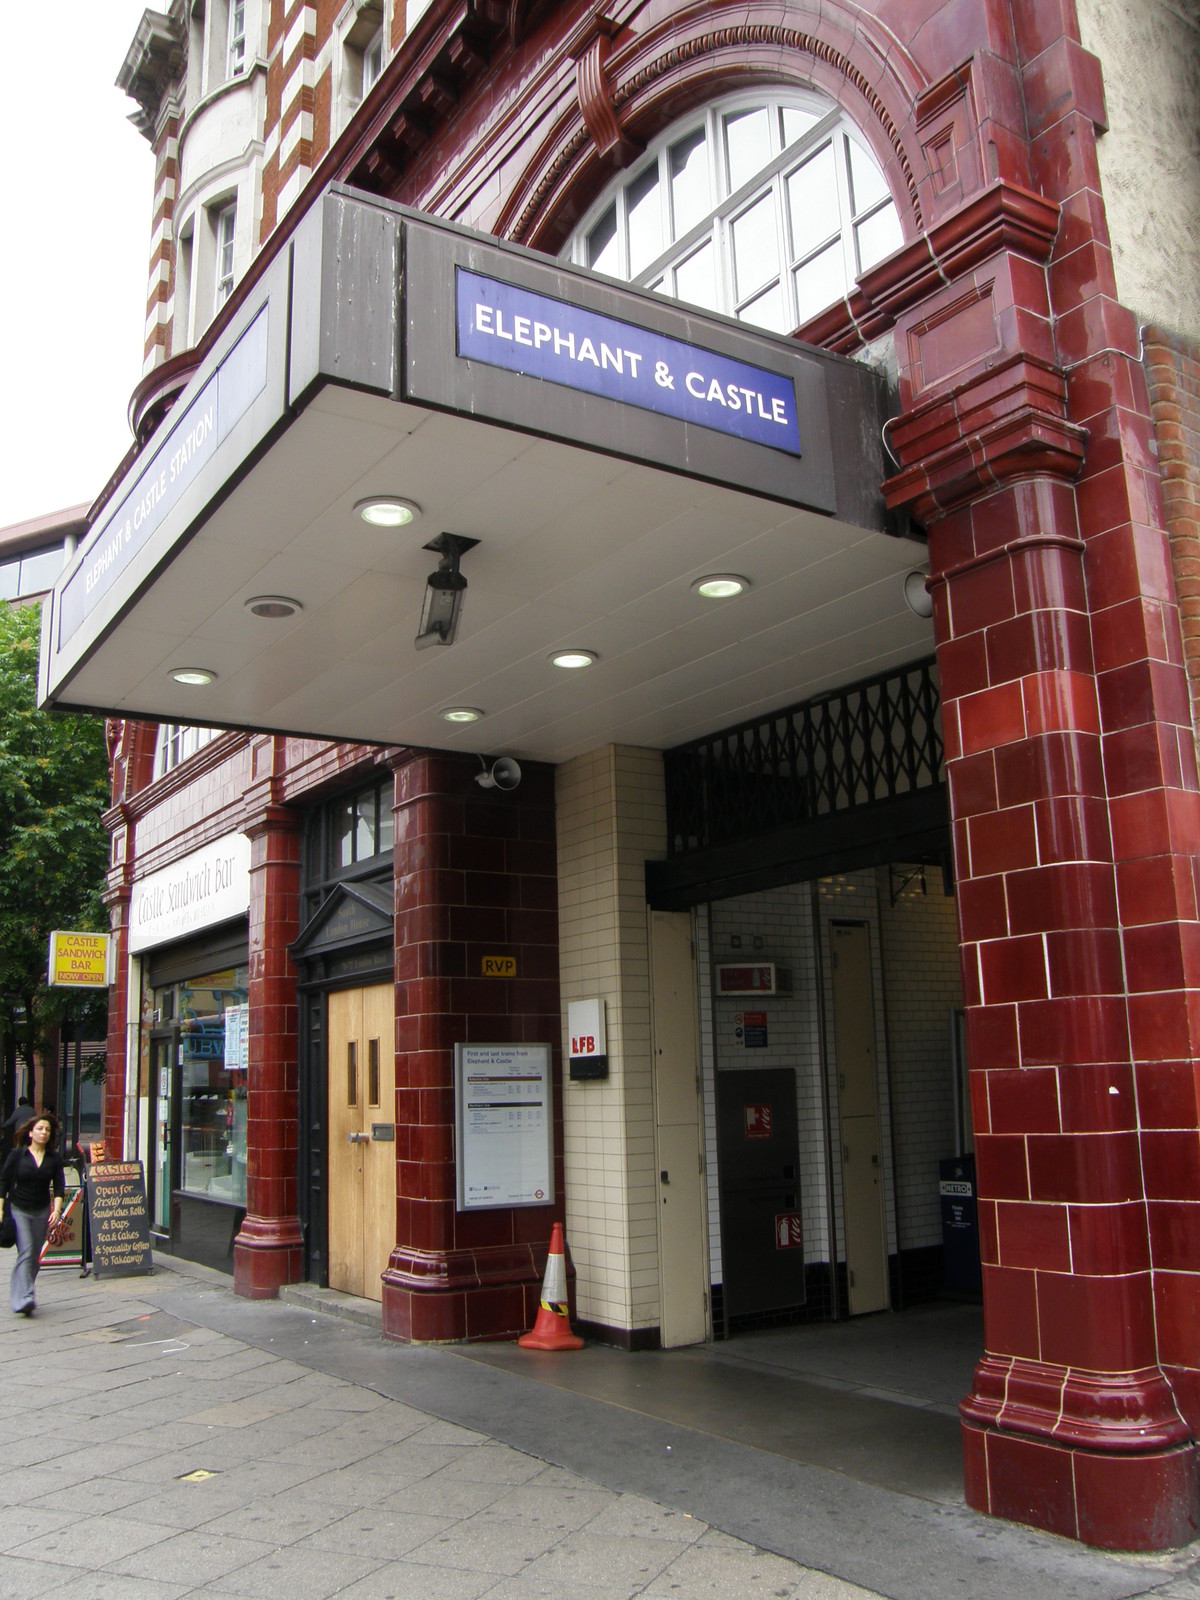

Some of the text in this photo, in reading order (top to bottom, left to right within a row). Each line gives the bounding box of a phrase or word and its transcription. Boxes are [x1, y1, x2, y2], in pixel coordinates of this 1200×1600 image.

[475, 303, 788, 425] ELEPHANT & CASTLE
[85, 406, 214, 594] ELEPHANT & CASTLE STATION
[138, 885, 165, 925] Castle
[166, 862, 211, 914] Sandwich
[215, 856, 236, 894] Bar
[66, 936, 98, 947] CASTLE
[57, 947, 107, 959] SANDWICH
[71, 960, 92, 970] BAR
[485, 960, 513, 973] RVP
[59, 972, 103, 981] NOW OPEN
[571, 1035, 596, 1054] LFB
[95, 1184, 134, 1197] Open for
[945, 1184, 968, 1193] METRO
[93, 1195, 143, 1210] freshly made
[101, 1219, 130, 1231] & Baps
[97, 1232, 111, 1242] Tea
[117, 1230, 140, 1241] Cakes
[94, 1244, 102, 1255] &
[101, 1254, 144, 1267] To Takeaway
